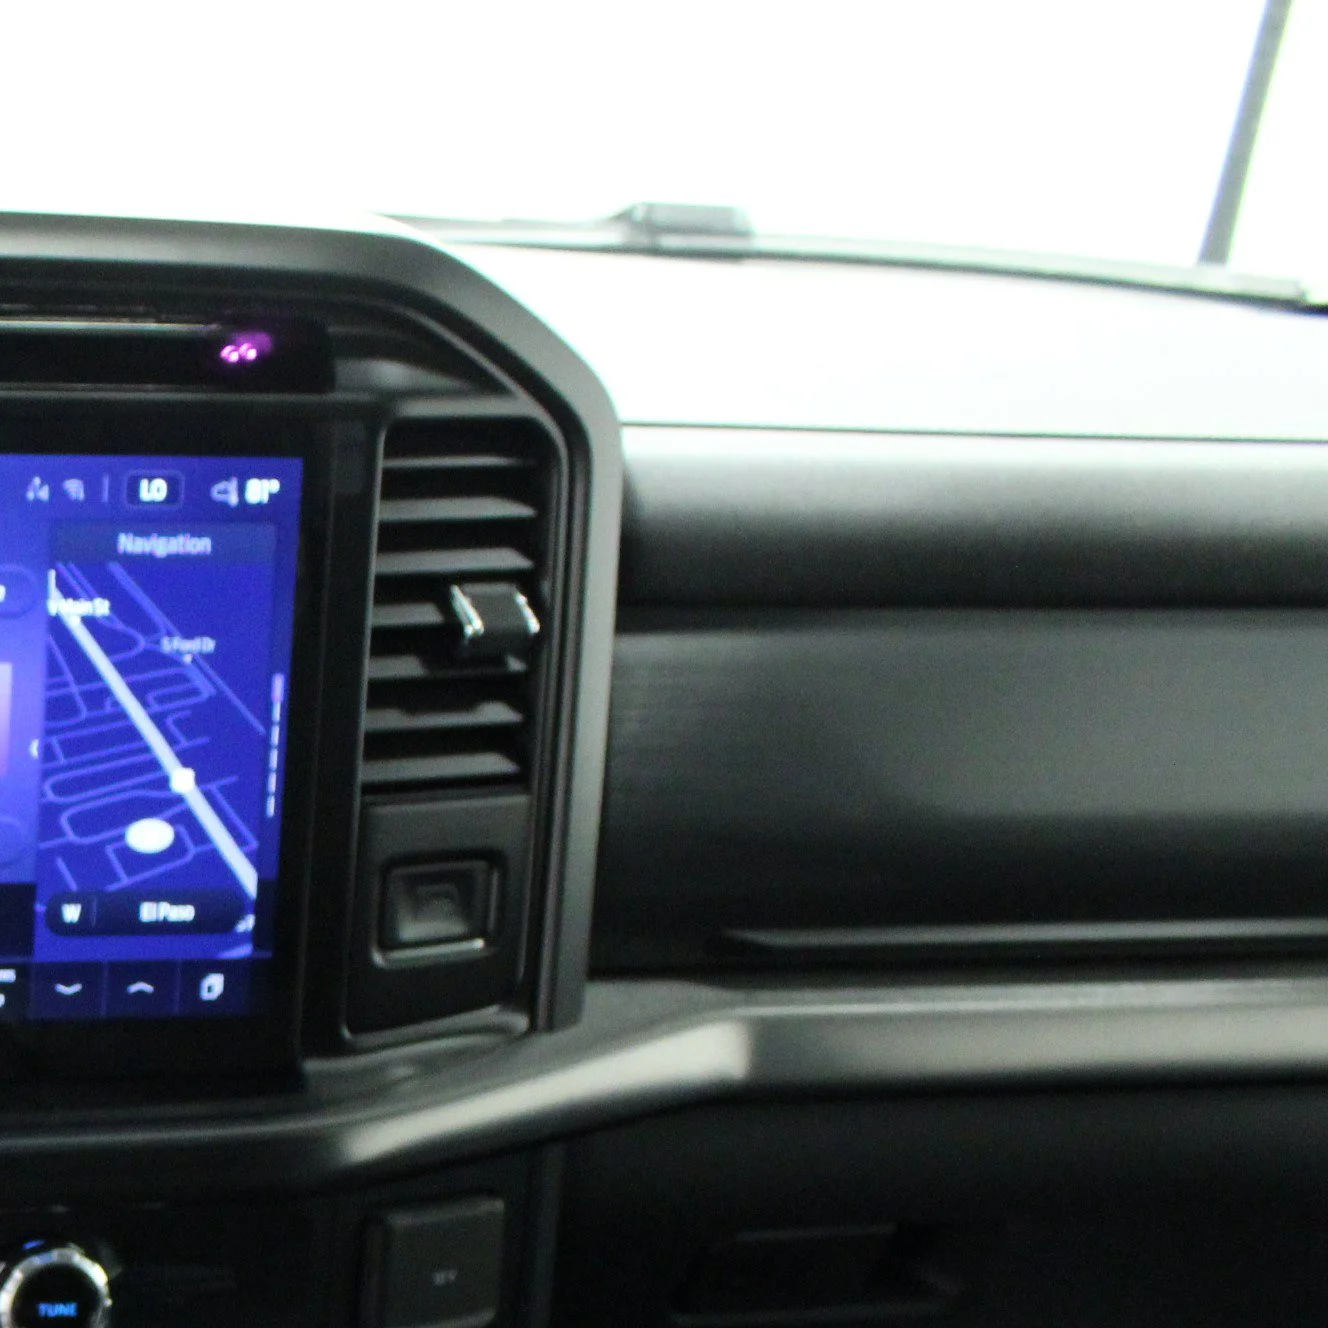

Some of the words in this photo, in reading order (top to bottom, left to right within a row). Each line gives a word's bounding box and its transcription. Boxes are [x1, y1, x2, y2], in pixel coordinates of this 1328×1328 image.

[139, 478, 168, 502] LO
[117, 533, 212, 558] Navigation
[62, 903, 82, 923] W
[38, 1301, 78, 1318] TUNE
